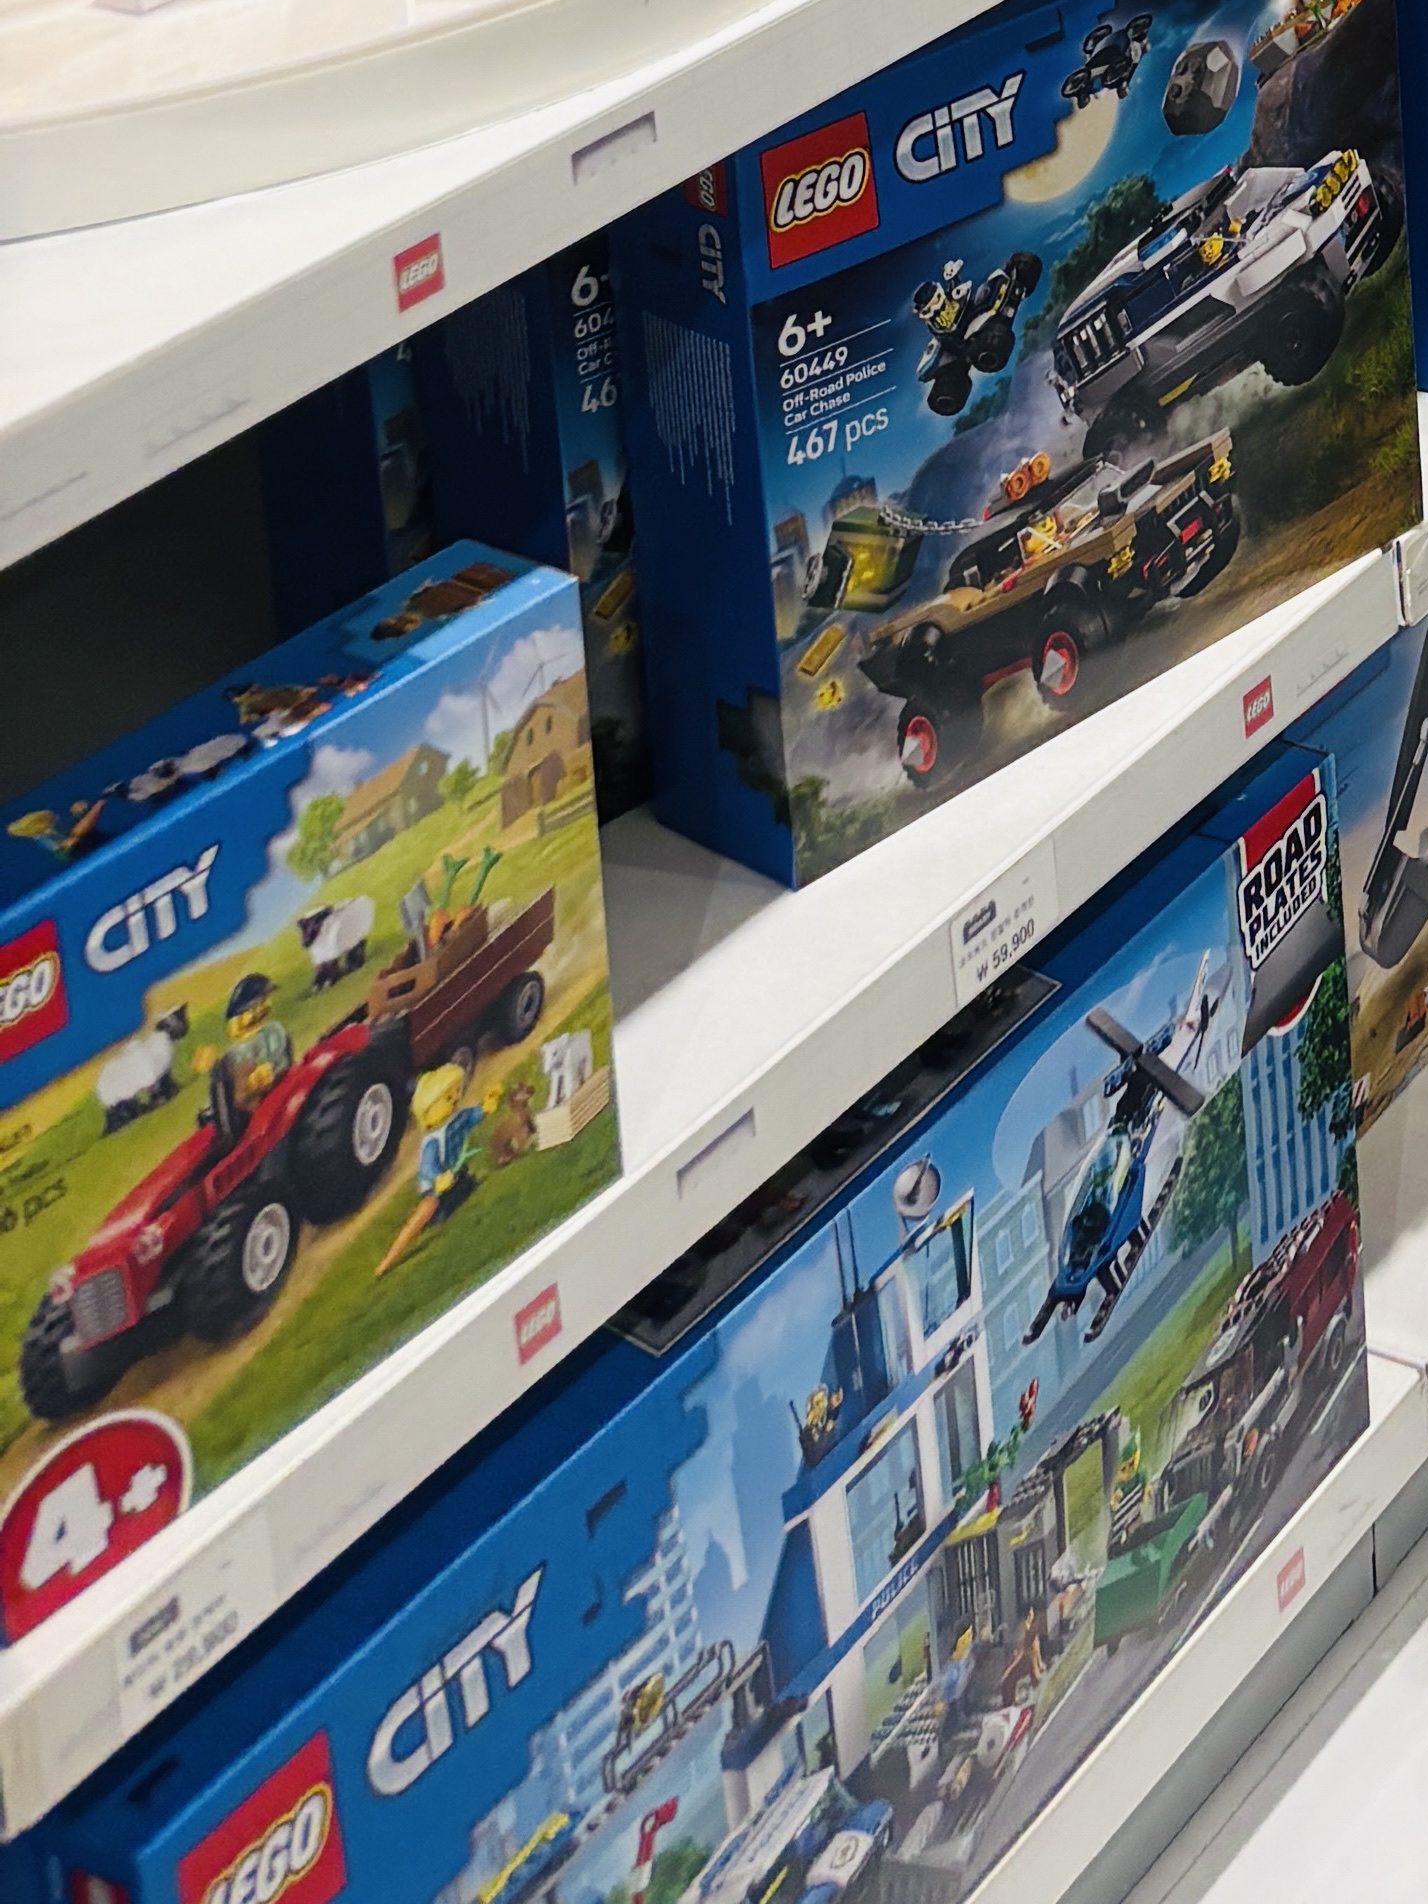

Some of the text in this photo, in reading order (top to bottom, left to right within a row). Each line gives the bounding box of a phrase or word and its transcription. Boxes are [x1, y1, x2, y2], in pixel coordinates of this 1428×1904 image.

[770, 71, 1025, 230] LEGO CITY
[400, 254, 438, 293] LEGO
[697, 223, 726, 305] CITY
[776, 308, 833, 359] 6+
[779, 347, 849, 389] 60449
[781, 358, 887, 412] Off-Road Police
[783, 390, 851, 427] Car Chase
[785, 409, 890, 468] 467 pcs
[1245, 689, 1272, 727] LEGO
[1241, 801, 1325, 919] ROAD
[85, 843, 220, 974] CITY
[1245, 842, 1324, 950] PLATES
[1250, 878, 1320, 965] INCLUDED
[990, 917, 1037, 974] 59,900
[519, 1299, 559, 1347] LEGO
[18, 1460, 168, 1590] 4+
[365, 1558, 548, 1798] CITY
